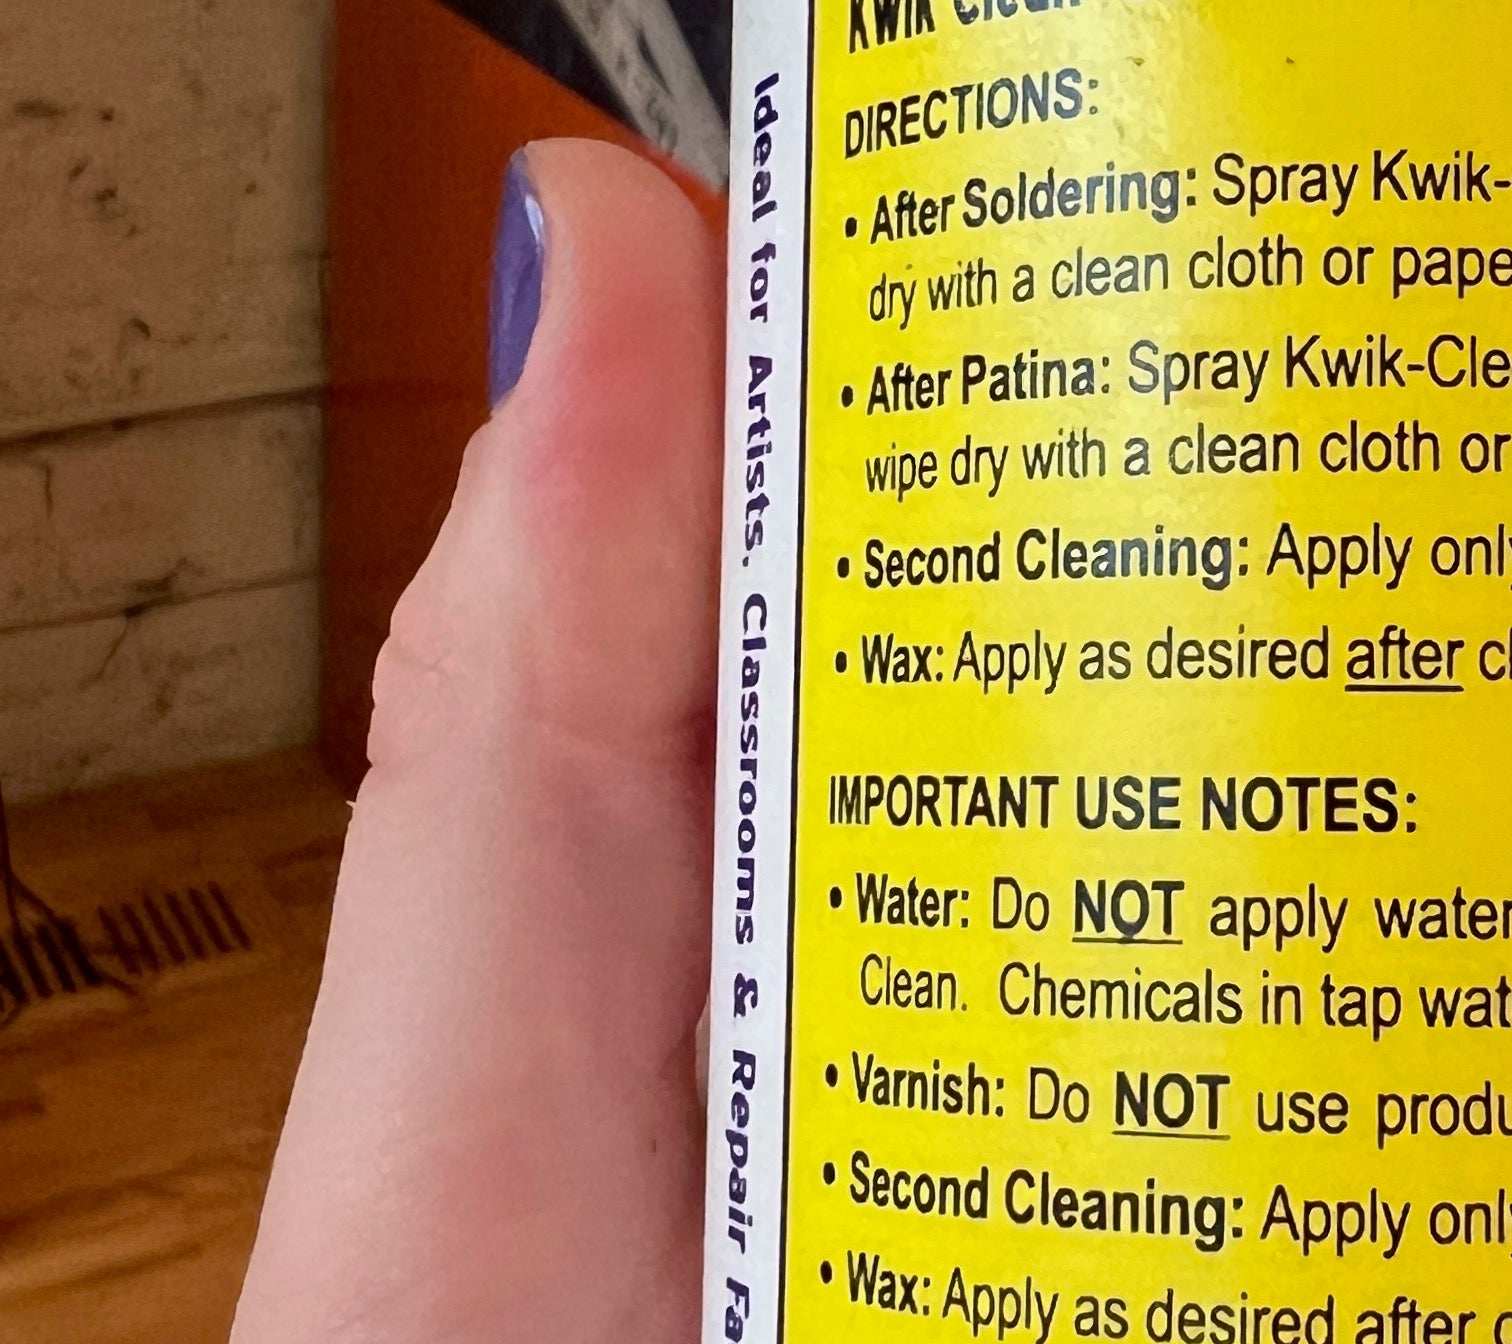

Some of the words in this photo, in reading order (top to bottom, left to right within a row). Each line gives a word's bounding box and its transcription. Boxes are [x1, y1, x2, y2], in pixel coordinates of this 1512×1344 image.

[752, 72, 780, 223] Ideal
[844, 67, 1099, 160] DIRECTIONS:
[870, 189, 956, 245] After
[962, 161, 1197, 228] Soldering:
[1212, 152, 1359, 218] Spray
[749, 242, 777, 324] for
[869, 272, 917, 331] dry
[927, 257, 997, 312] with
[1012, 264, 1035, 303] a
[1051, 246, 1169, 299] clean
[1188, 233, 1303, 289] cloth
[1322, 245, 1375, 286] or
[866, 362, 953, 416] After
[962, 348, 1110, 405] Patina:
[1128, 339, 1270, 406] Spray
[865, 442, 938, 503] wipe
[950, 434, 1009, 498] dry
[1021, 426, 1106, 480] with
[1124, 437, 1151, 477] a
[1168, 422, 1300, 475] clean
[1319, 419, 1440, 473] cloth
[1460, 432, 1512, 474] or
[864, 530, 1001, 589] Second
[1016, 524, 1249, 592] Cleaning:
[1266, 521, 1413, 591] Apply
[861, 632, 944, 685] Wax:
[952, 629, 1067, 695] Apply
[1079, 640, 1132, 681] as
[1146, 623, 1329, 680] desired
[1346, 624, 1465, 681] after
[735, 593, 768, 945] Classrooms
[829, 774, 1060, 829] IMPORTANT
[1076, 775, 1182, 831] USE
[1202, 776, 1417, 834] NOTES:
[855, 872, 970, 929] Water:
[992, 876, 1050, 932] Do
[1071, 879, 1185, 945] NOT
[1210, 882, 1349, 954] apply
[733, 972, 759, 1019] &
[860, 953, 968, 1012] Clean.
[999, 961, 1243, 1025] Chemicals
[1261, 969, 1302, 1026] in
[1320, 973, 1402, 1043] tap
[851, 1050, 1005, 1118] Varnish:
[1029, 1066, 1090, 1124] Do
[1115, 1070, 1231, 1130] NOT
[1257, 1091, 1349, 1135] use
[725, 1049, 757, 1255] Repair
[849, 1150, 989, 1219] Second
[1004, 1168, 1244, 1253] Cleaning:
[1259, 1184, 1411, 1260] Apply
[846, 1249, 931, 1317] Wax:
[1074, 1295, 1129, 1340] as
